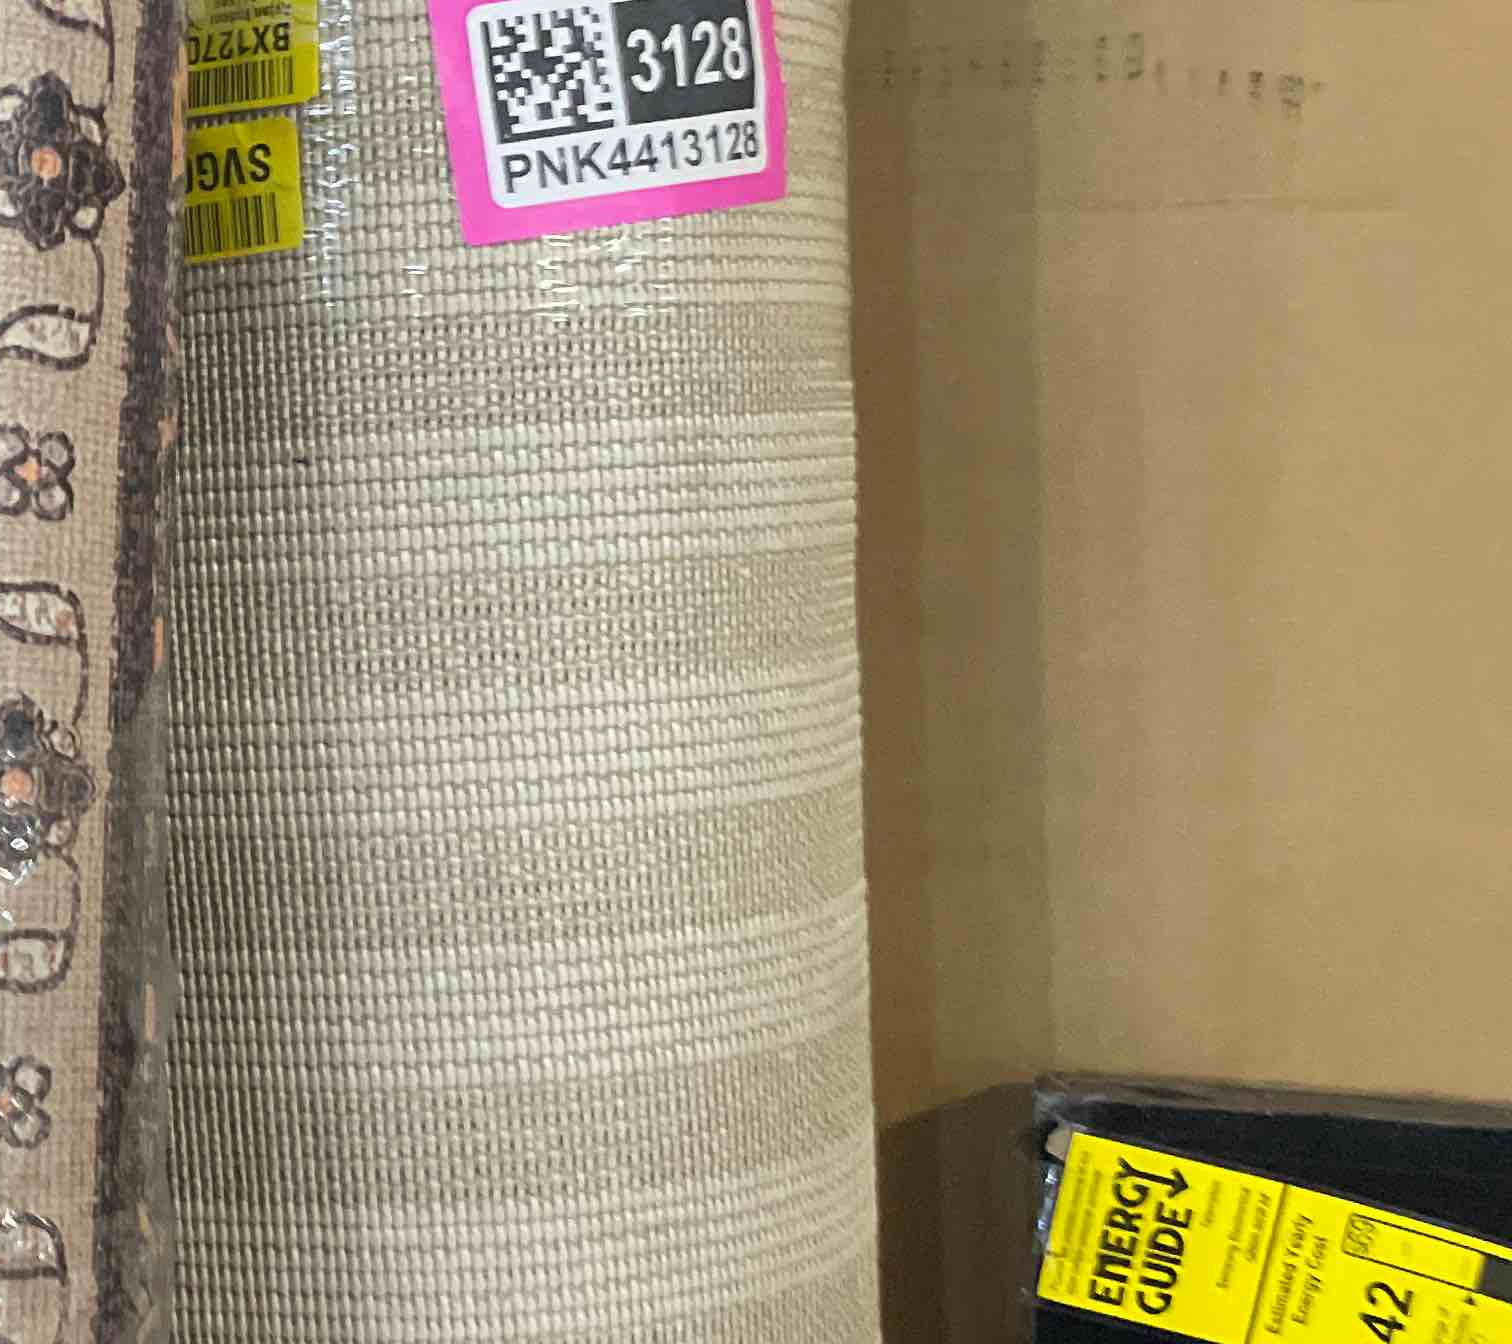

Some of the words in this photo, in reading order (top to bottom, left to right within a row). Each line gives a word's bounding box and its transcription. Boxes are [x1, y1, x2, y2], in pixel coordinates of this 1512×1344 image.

[626, 17, 751, 94] 3128
[502, 119, 760, 194] PNK4413128
[1088, 1156, 1156, 1307] ENERGY
[1136, 1202, 1193, 1316] GUIDE
